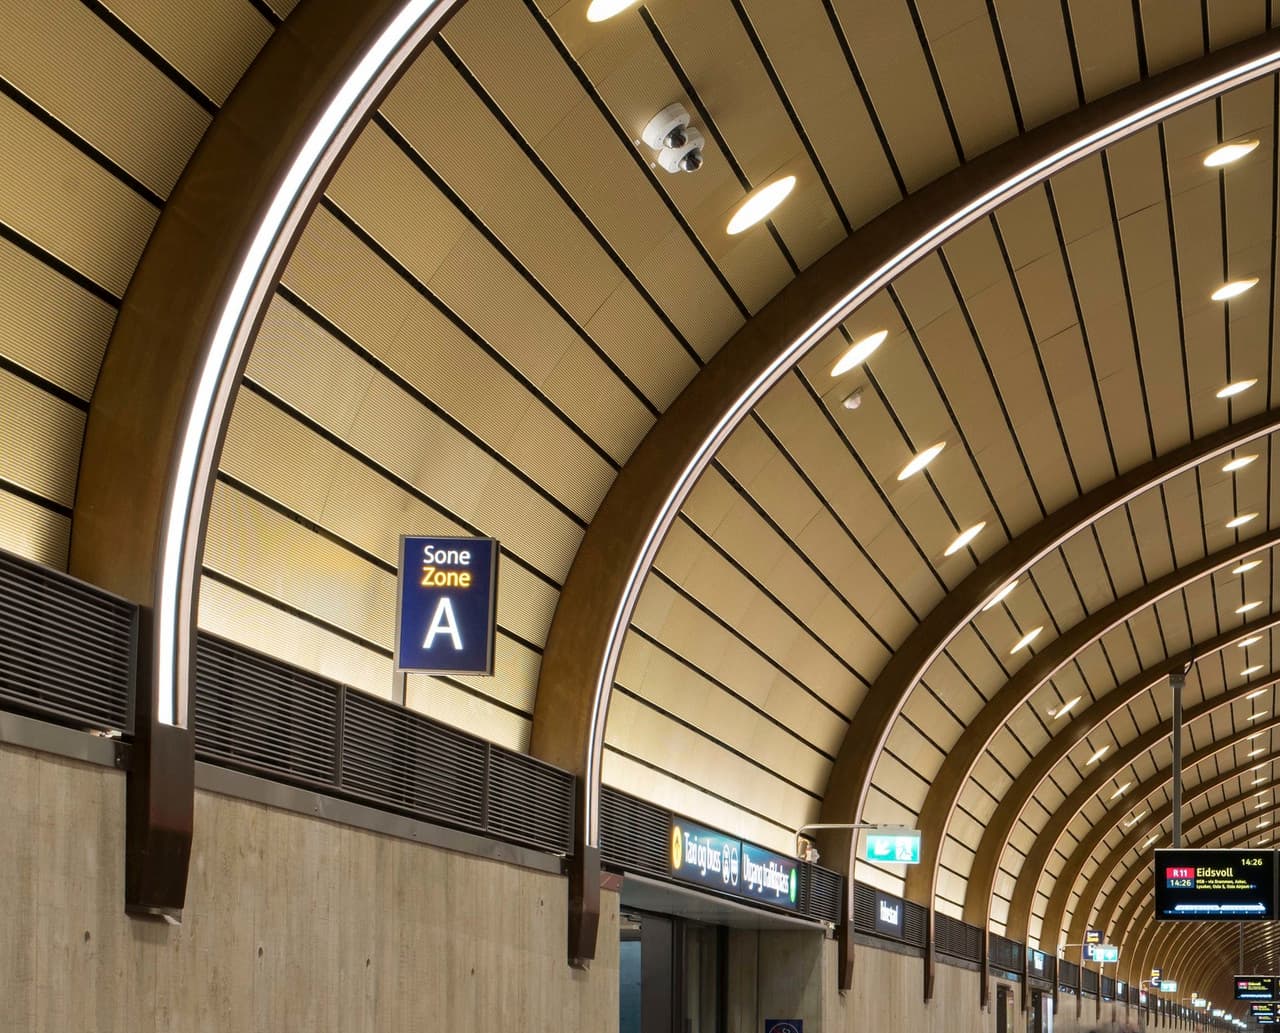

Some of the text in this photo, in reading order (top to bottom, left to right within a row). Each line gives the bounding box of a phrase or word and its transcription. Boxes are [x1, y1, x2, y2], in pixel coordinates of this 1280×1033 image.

[423, 544, 471, 565] Sone
[421, 566, 471, 587] Zone
[422, 597, 463, 650] A
[684, 832, 721, 877] Taxi og buss
[1241, 858, 1263, 866] 14:26
[1196, 867, 1233, 877] Eidsvoll
[1170, 879, 1191, 887] 14:26
